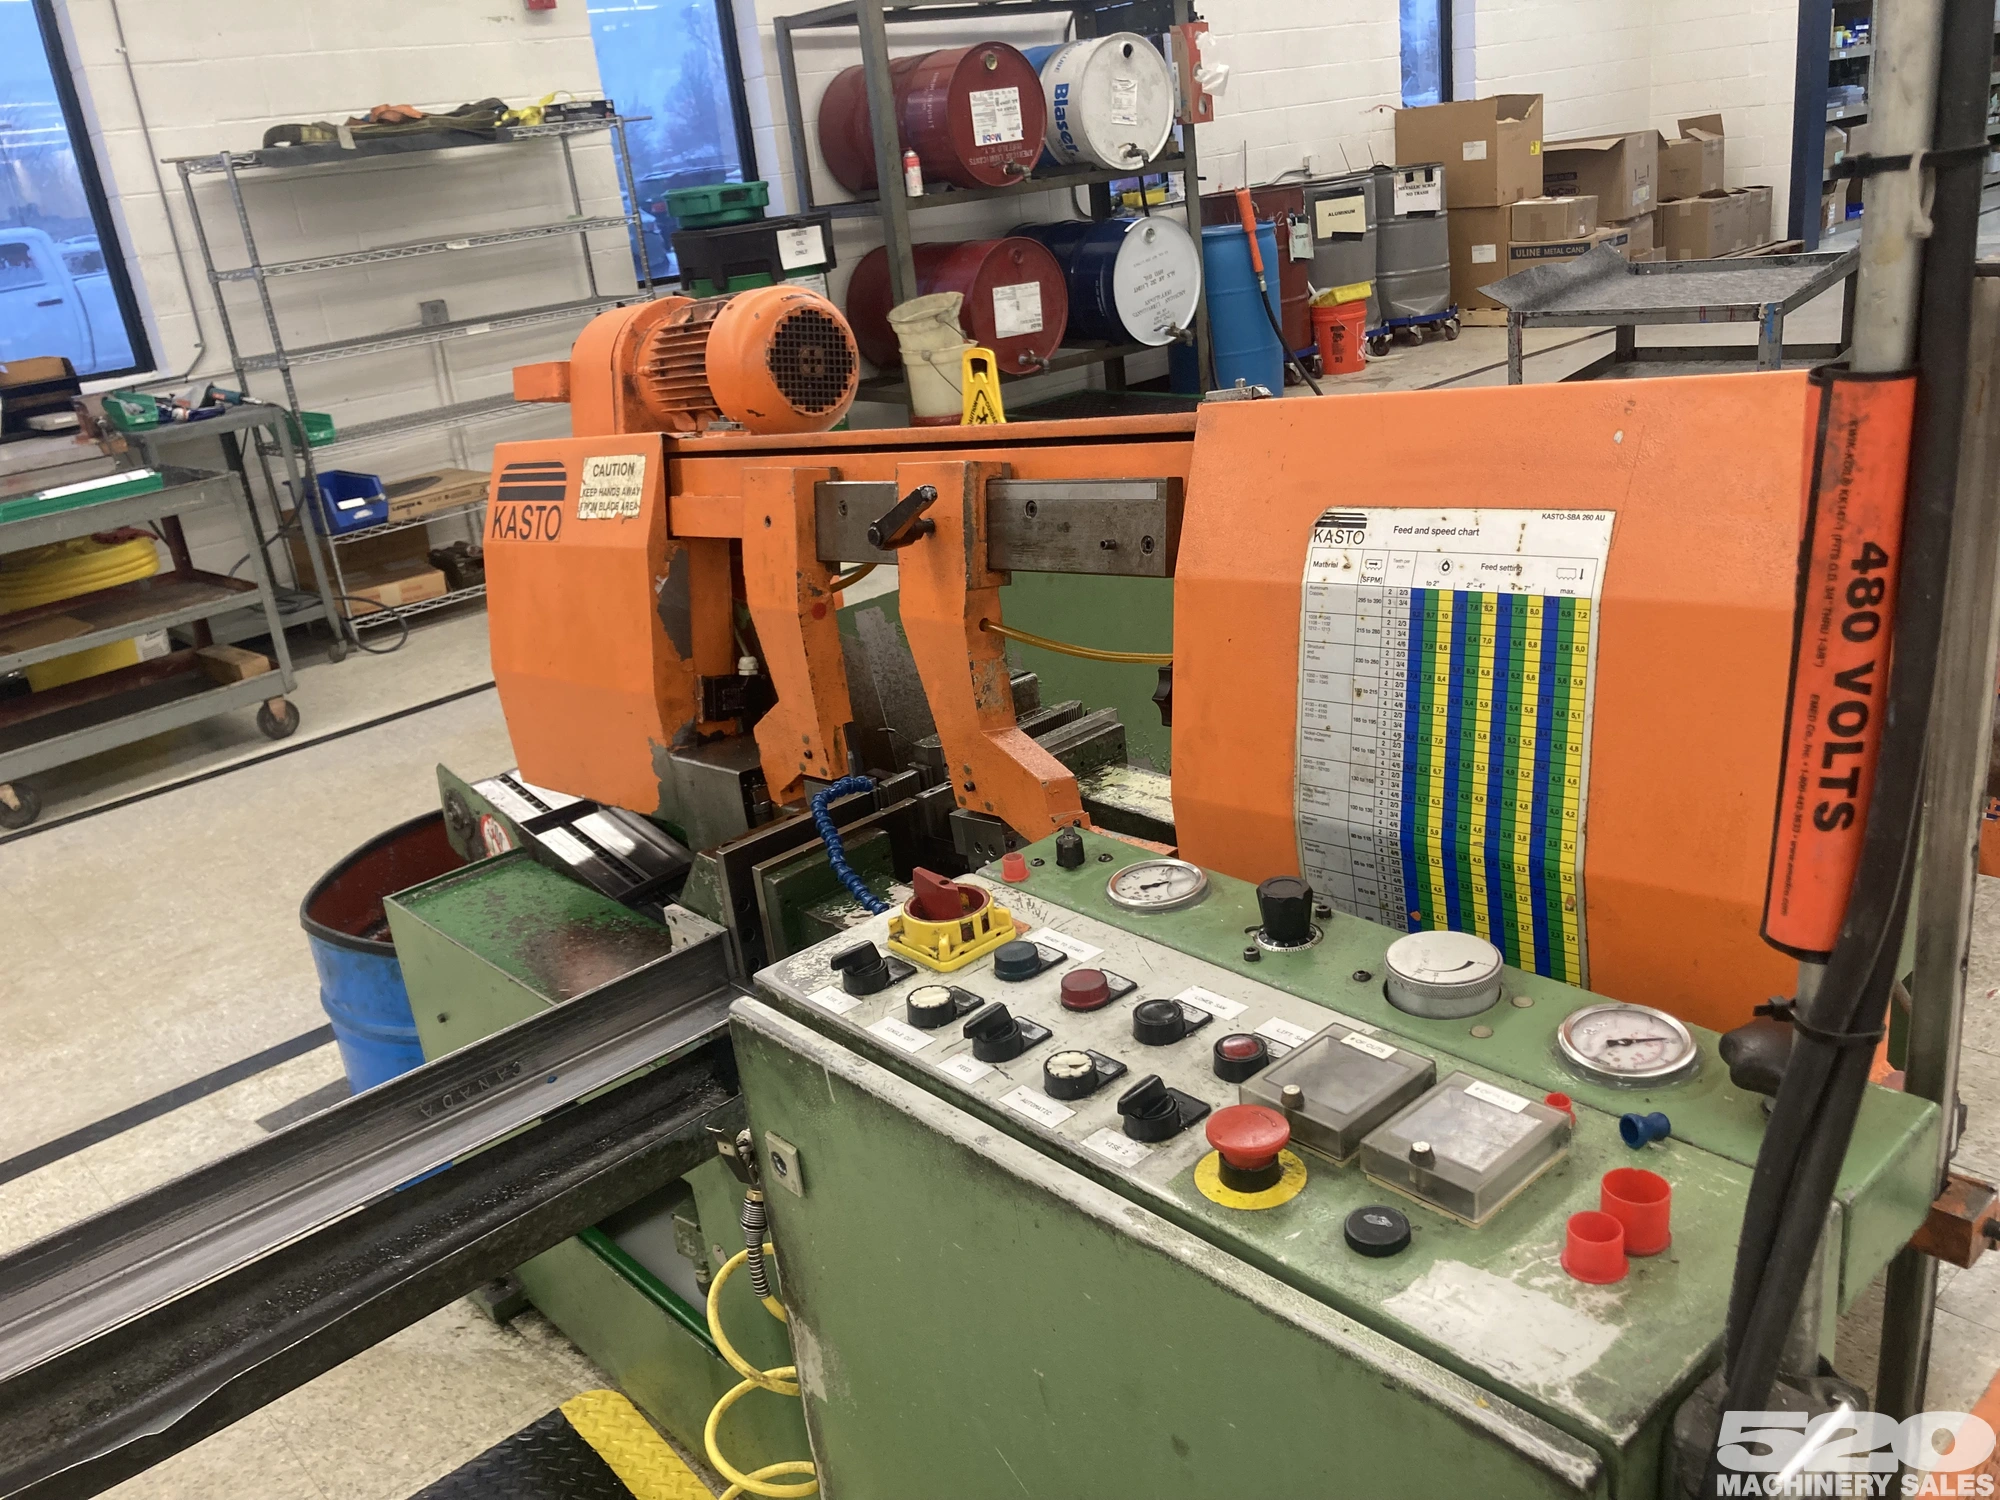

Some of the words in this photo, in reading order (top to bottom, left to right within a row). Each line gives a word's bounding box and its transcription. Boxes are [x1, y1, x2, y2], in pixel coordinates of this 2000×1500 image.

[1053, 83, 1079, 152] Blaser
[982, 133, 1002, 143] Mobil
[1328, 209, 1356, 217] ALUMINUM
[1516, 247, 1541, 257] ULINE
[1544, 248, 1565, 256] METAL
[1566, 245, 1585, 254] CANS
[592, 462, 636, 477] CAUTION
[582, 488, 598, 497] KEEP
[599, 487, 620, 497] HANDS
[621, 486, 642, 497] AWAY
[599, 501, 619, 511] BLADE
[620, 501, 638, 511] AREA
[491, 504, 562, 541] KASTO
[1542, 513, 1580, 521] KASTO-SBA
[1313, 529, 1365, 545] KASTO
[1393, 526, 1413, 535] Feed
[1414, 527, 1430, 535] and
[1431, 527, 1456, 537] speed
[1458, 528, 1480, 536] chart
[1481, 563, 1498, 571] Feed
[1499, 564, 1523, 572] setting
[1841, 541, 1889, 643] 480
[1819, 607, 1832, 637] THRU
[1807, 694, 1820, 722] EMED
[1813, 660, 1876, 832] VOLTS
[1194, 995, 1215, 1007] LOWER
[885, 1026, 904, 1037] SINGLE
[1276, 1028, 1293, 1038] LIFT
[1355, 1039, 1366, 1047] OF
[1366, 1042, 1386, 1053] CUTS
[956, 1064, 972, 1073] FEED
[420, 1061, 521, 1118] CANADA
[1020, 1098, 1053, 1116] AUTOMATIC
[1105, 1141, 1121, 1151] VISE
